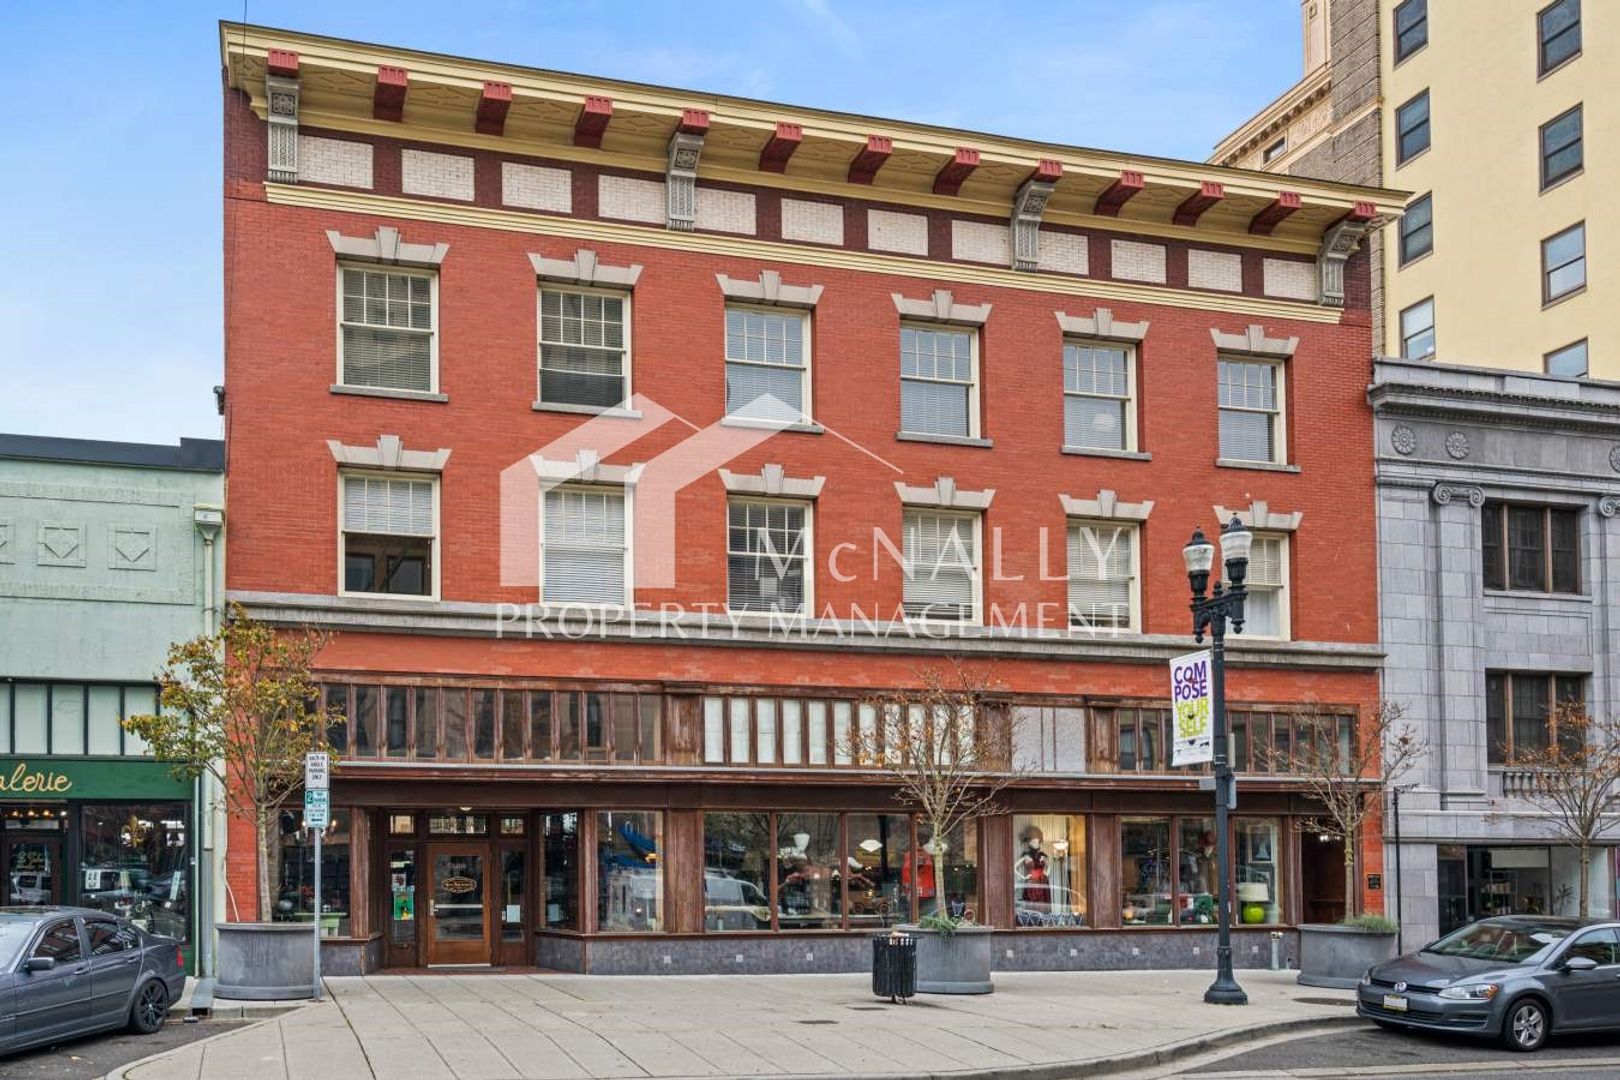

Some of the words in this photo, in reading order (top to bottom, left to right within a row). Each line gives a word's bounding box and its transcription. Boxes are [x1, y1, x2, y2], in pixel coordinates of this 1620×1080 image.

[1174, 661, 1207, 684] COM
[1174, 680, 1208, 703] POSE
[1175, 698, 1209, 721] YOUR
[1179, 716, 1208, 738] SELF
